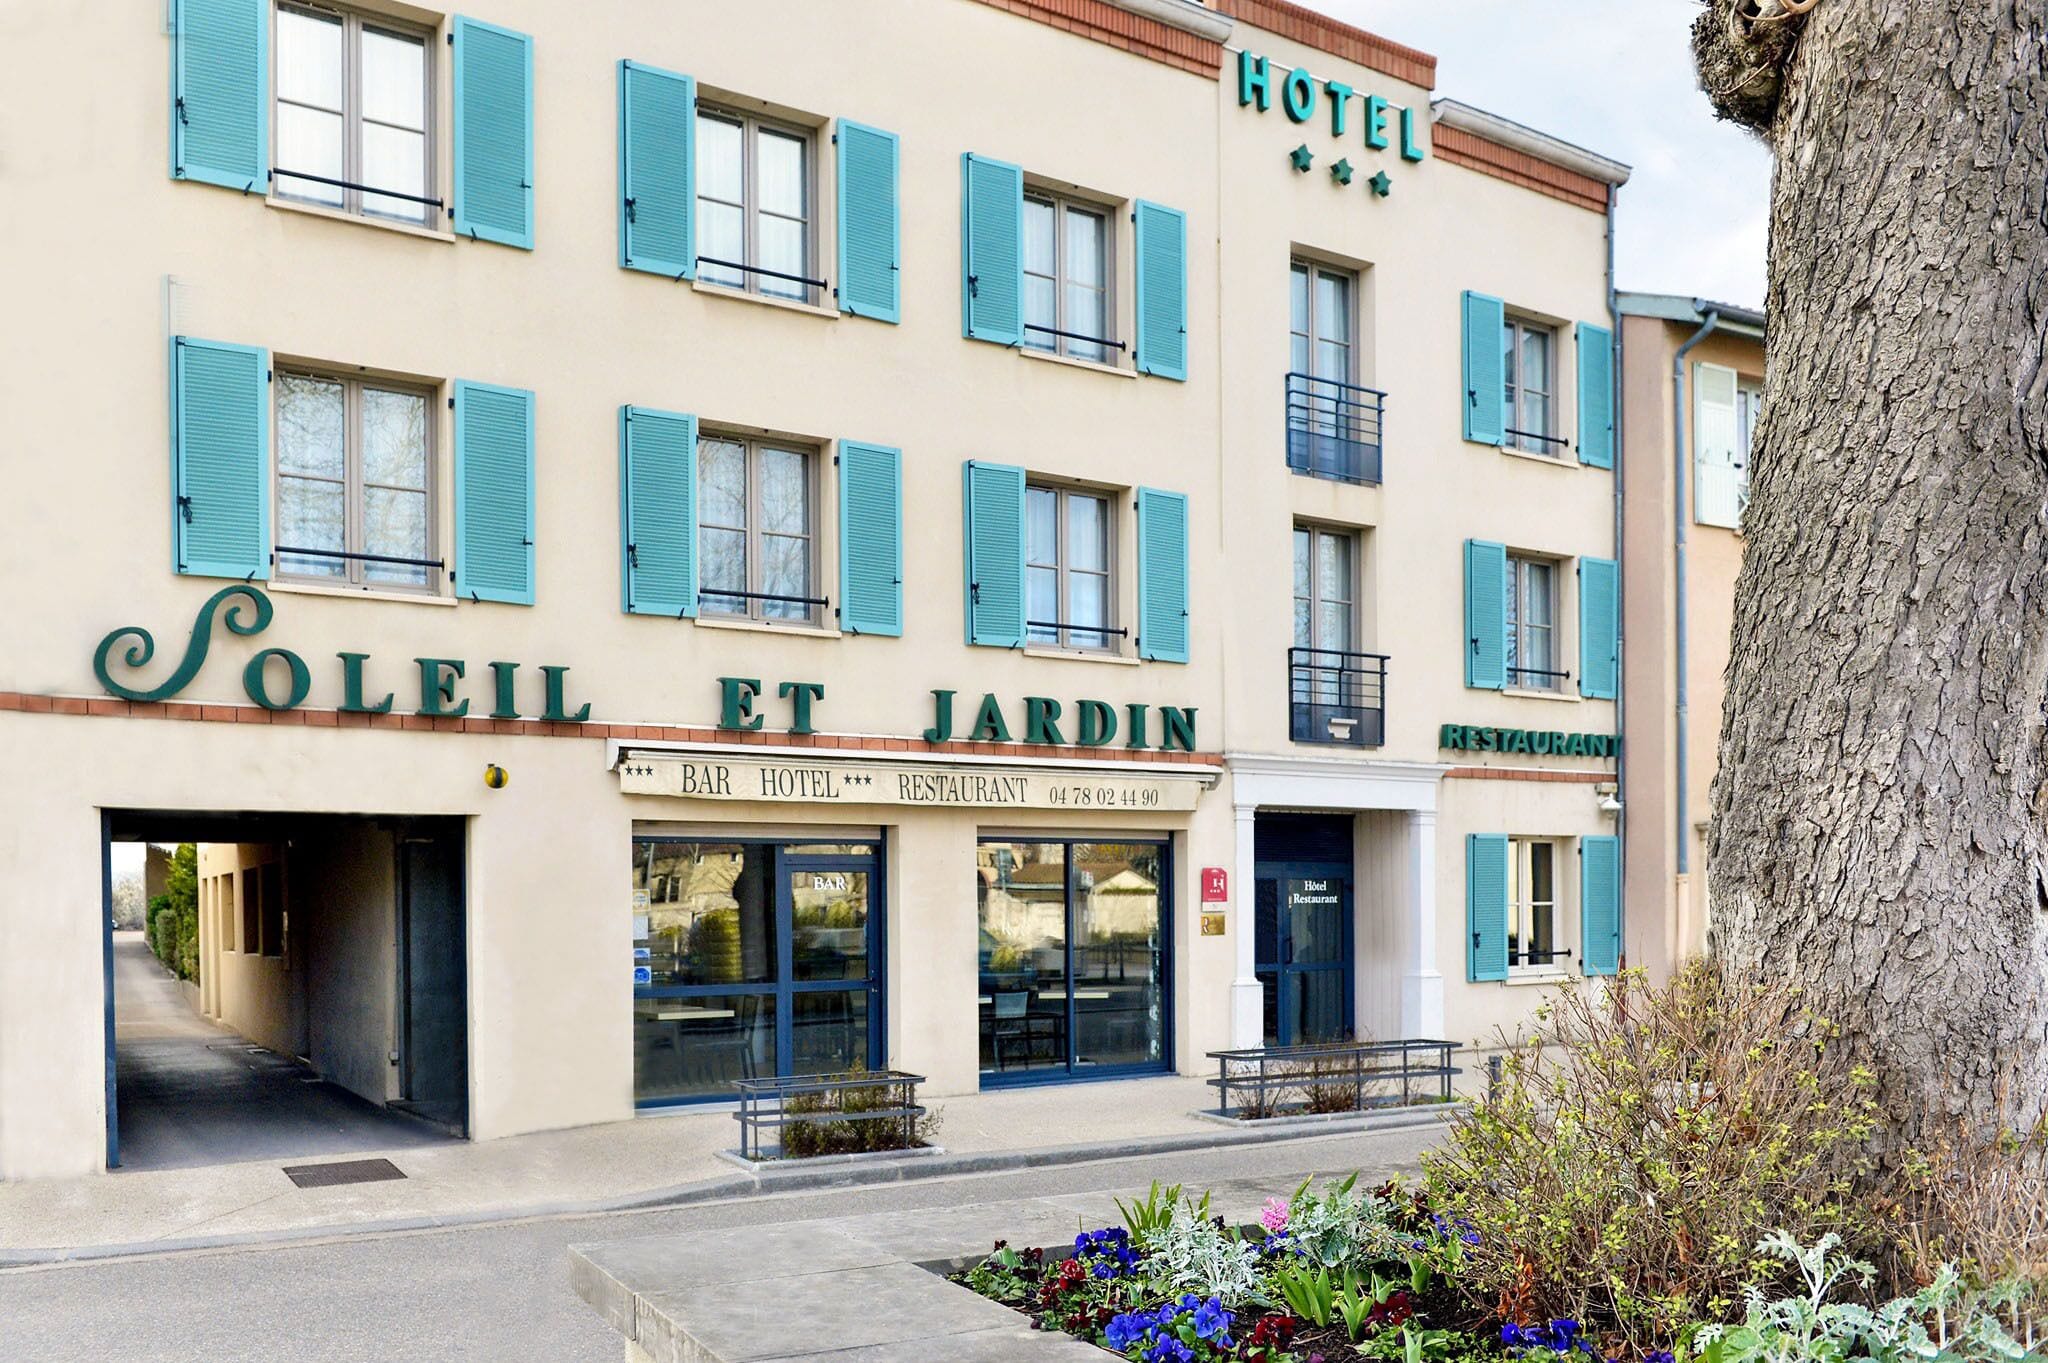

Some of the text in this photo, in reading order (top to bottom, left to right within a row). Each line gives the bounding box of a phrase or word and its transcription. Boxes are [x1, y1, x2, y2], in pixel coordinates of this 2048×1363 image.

[1238, 50, 1424, 162] HOTEL
[93, 585, 1199, 752] SOLEIL ET JARDIN
[682, 764, 1159, 806] BAR HOTEL RESTAURANT 04 78 02 44 90
[813, 876, 846, 890] BAR
[1304, 880, 1327, 891] Hôtel
[1293, 893, 1338, 904] Restaurant
